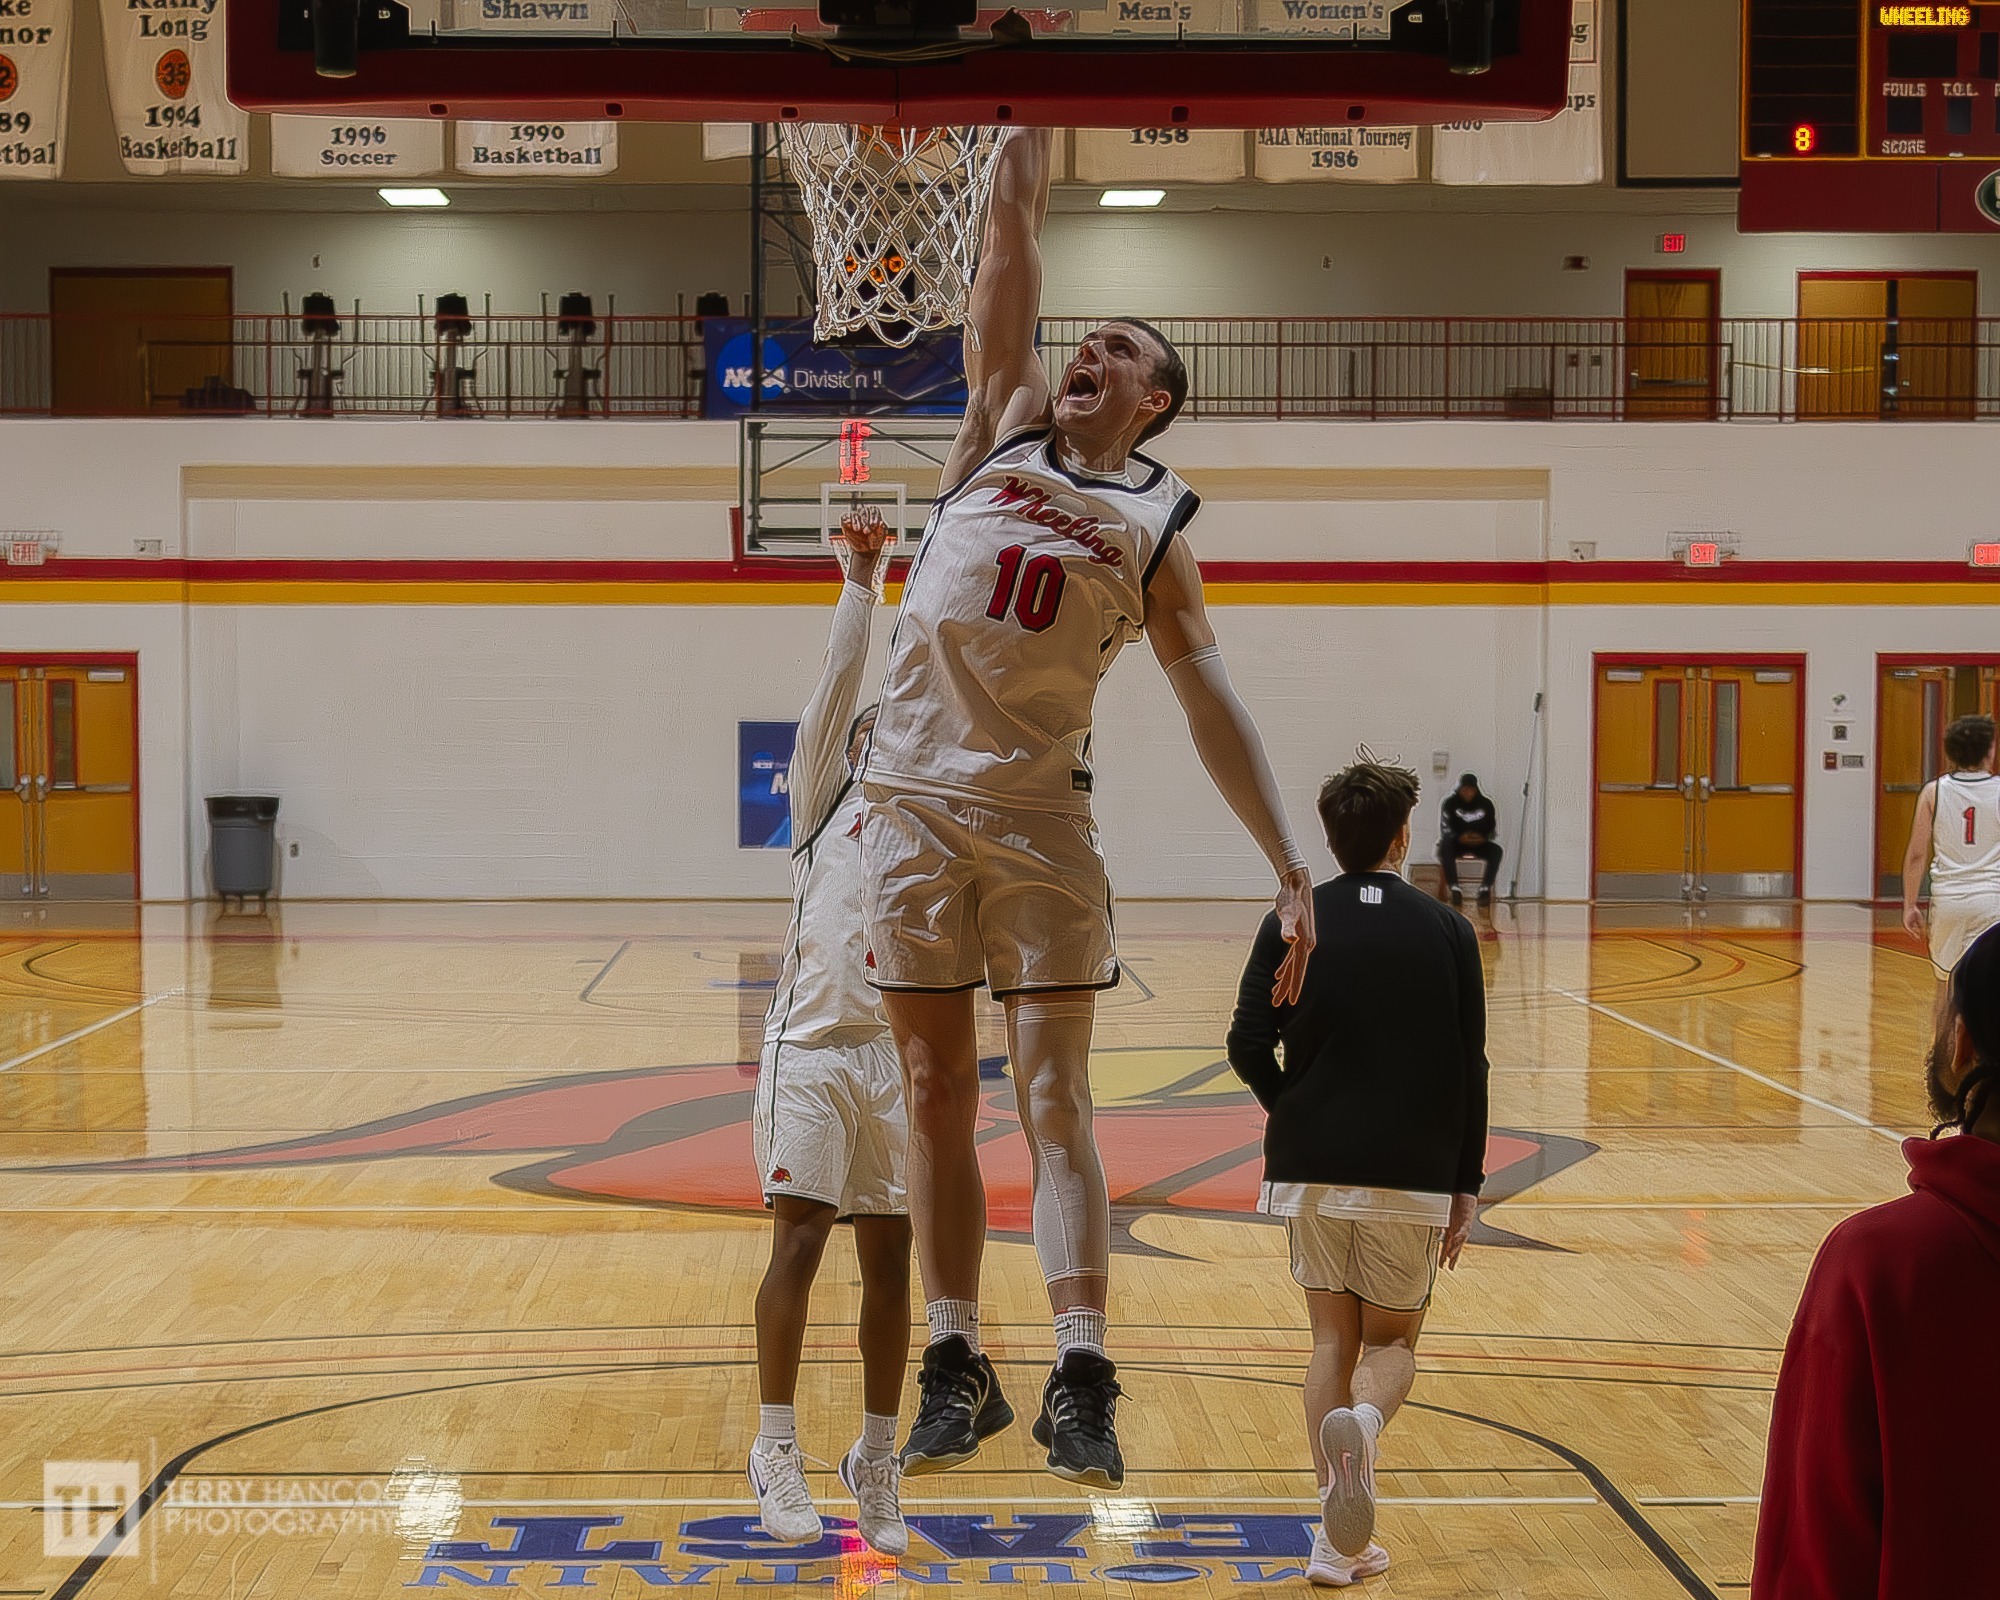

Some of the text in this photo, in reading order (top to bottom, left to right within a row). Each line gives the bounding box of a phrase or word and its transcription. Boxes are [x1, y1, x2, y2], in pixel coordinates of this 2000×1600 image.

[482, 0, 588, 19] Shawn
[1117, 1, 1191, 21] Men's
[1282, 0, 1384, 19] Women's
[1880, 6, 1971, 25] WHEELING
[138, 14, 211, 42] Long
[162, 62, 189, 86] 35
[1882, 82, 1927, 97] FOULS
[145, 105, 201, 128] 1994
[330, 126, 386, 145] 1996
[509, 124, 565, 142] 1990
[1129, 127, 1190, 145] 1958
[1296, 127, 1354, 147] National
[1358, 127, 1412, 150] Tourney
[1794, 126, 1811, 151] 8
[120, 136, 237, 160] Basketball
[472, 146, 602, 165] Basketball
[1881, 139, 1926, 154] SCORE
[320, 149, 398, 166] Soccer
[1311, 150, 1359, 168] 1986
[794, 369, 868, 388] Division
[986, 474, 1126, 568] Wheeling
[985, 542, 1069, 636] 10
[1963, 805, 1976, 846] 1
[422, 1514, 1324, 1563] EAST
